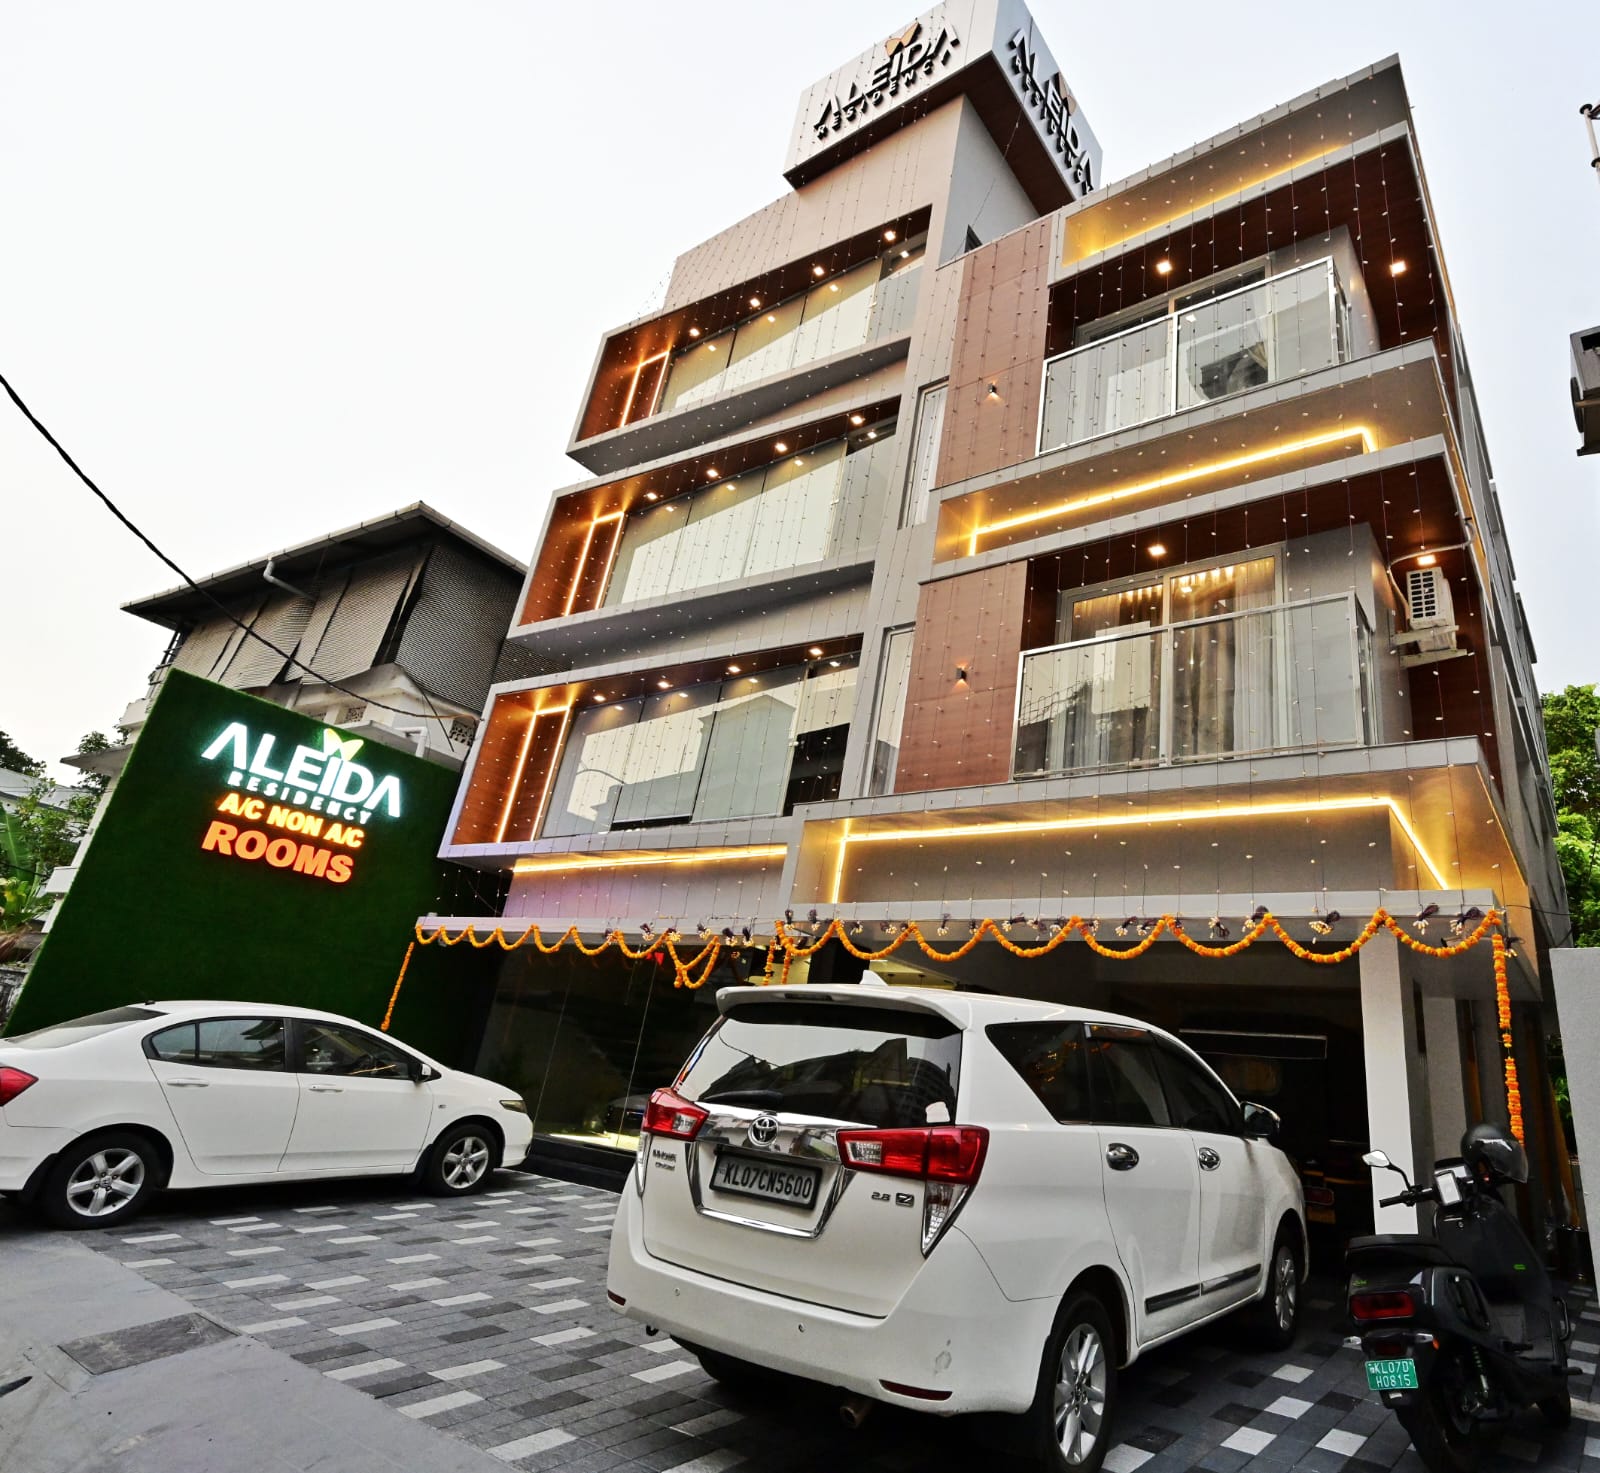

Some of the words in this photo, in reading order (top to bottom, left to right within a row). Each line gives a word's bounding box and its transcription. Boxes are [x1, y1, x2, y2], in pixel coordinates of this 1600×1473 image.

[813, 24, 960, 131] ALEIDA
[201, 722, 401, 818] ALEIDA
[227, 770, 372, 825] RESIDENCY
[217, 792, 265, 820] A/C
[266, 805, 323, 837] NON
[323, 822, 365, 848] A/C
[201, 820, 354, 883] ROOMS
[723, 1162, 813, 1199] KL07CN5600
